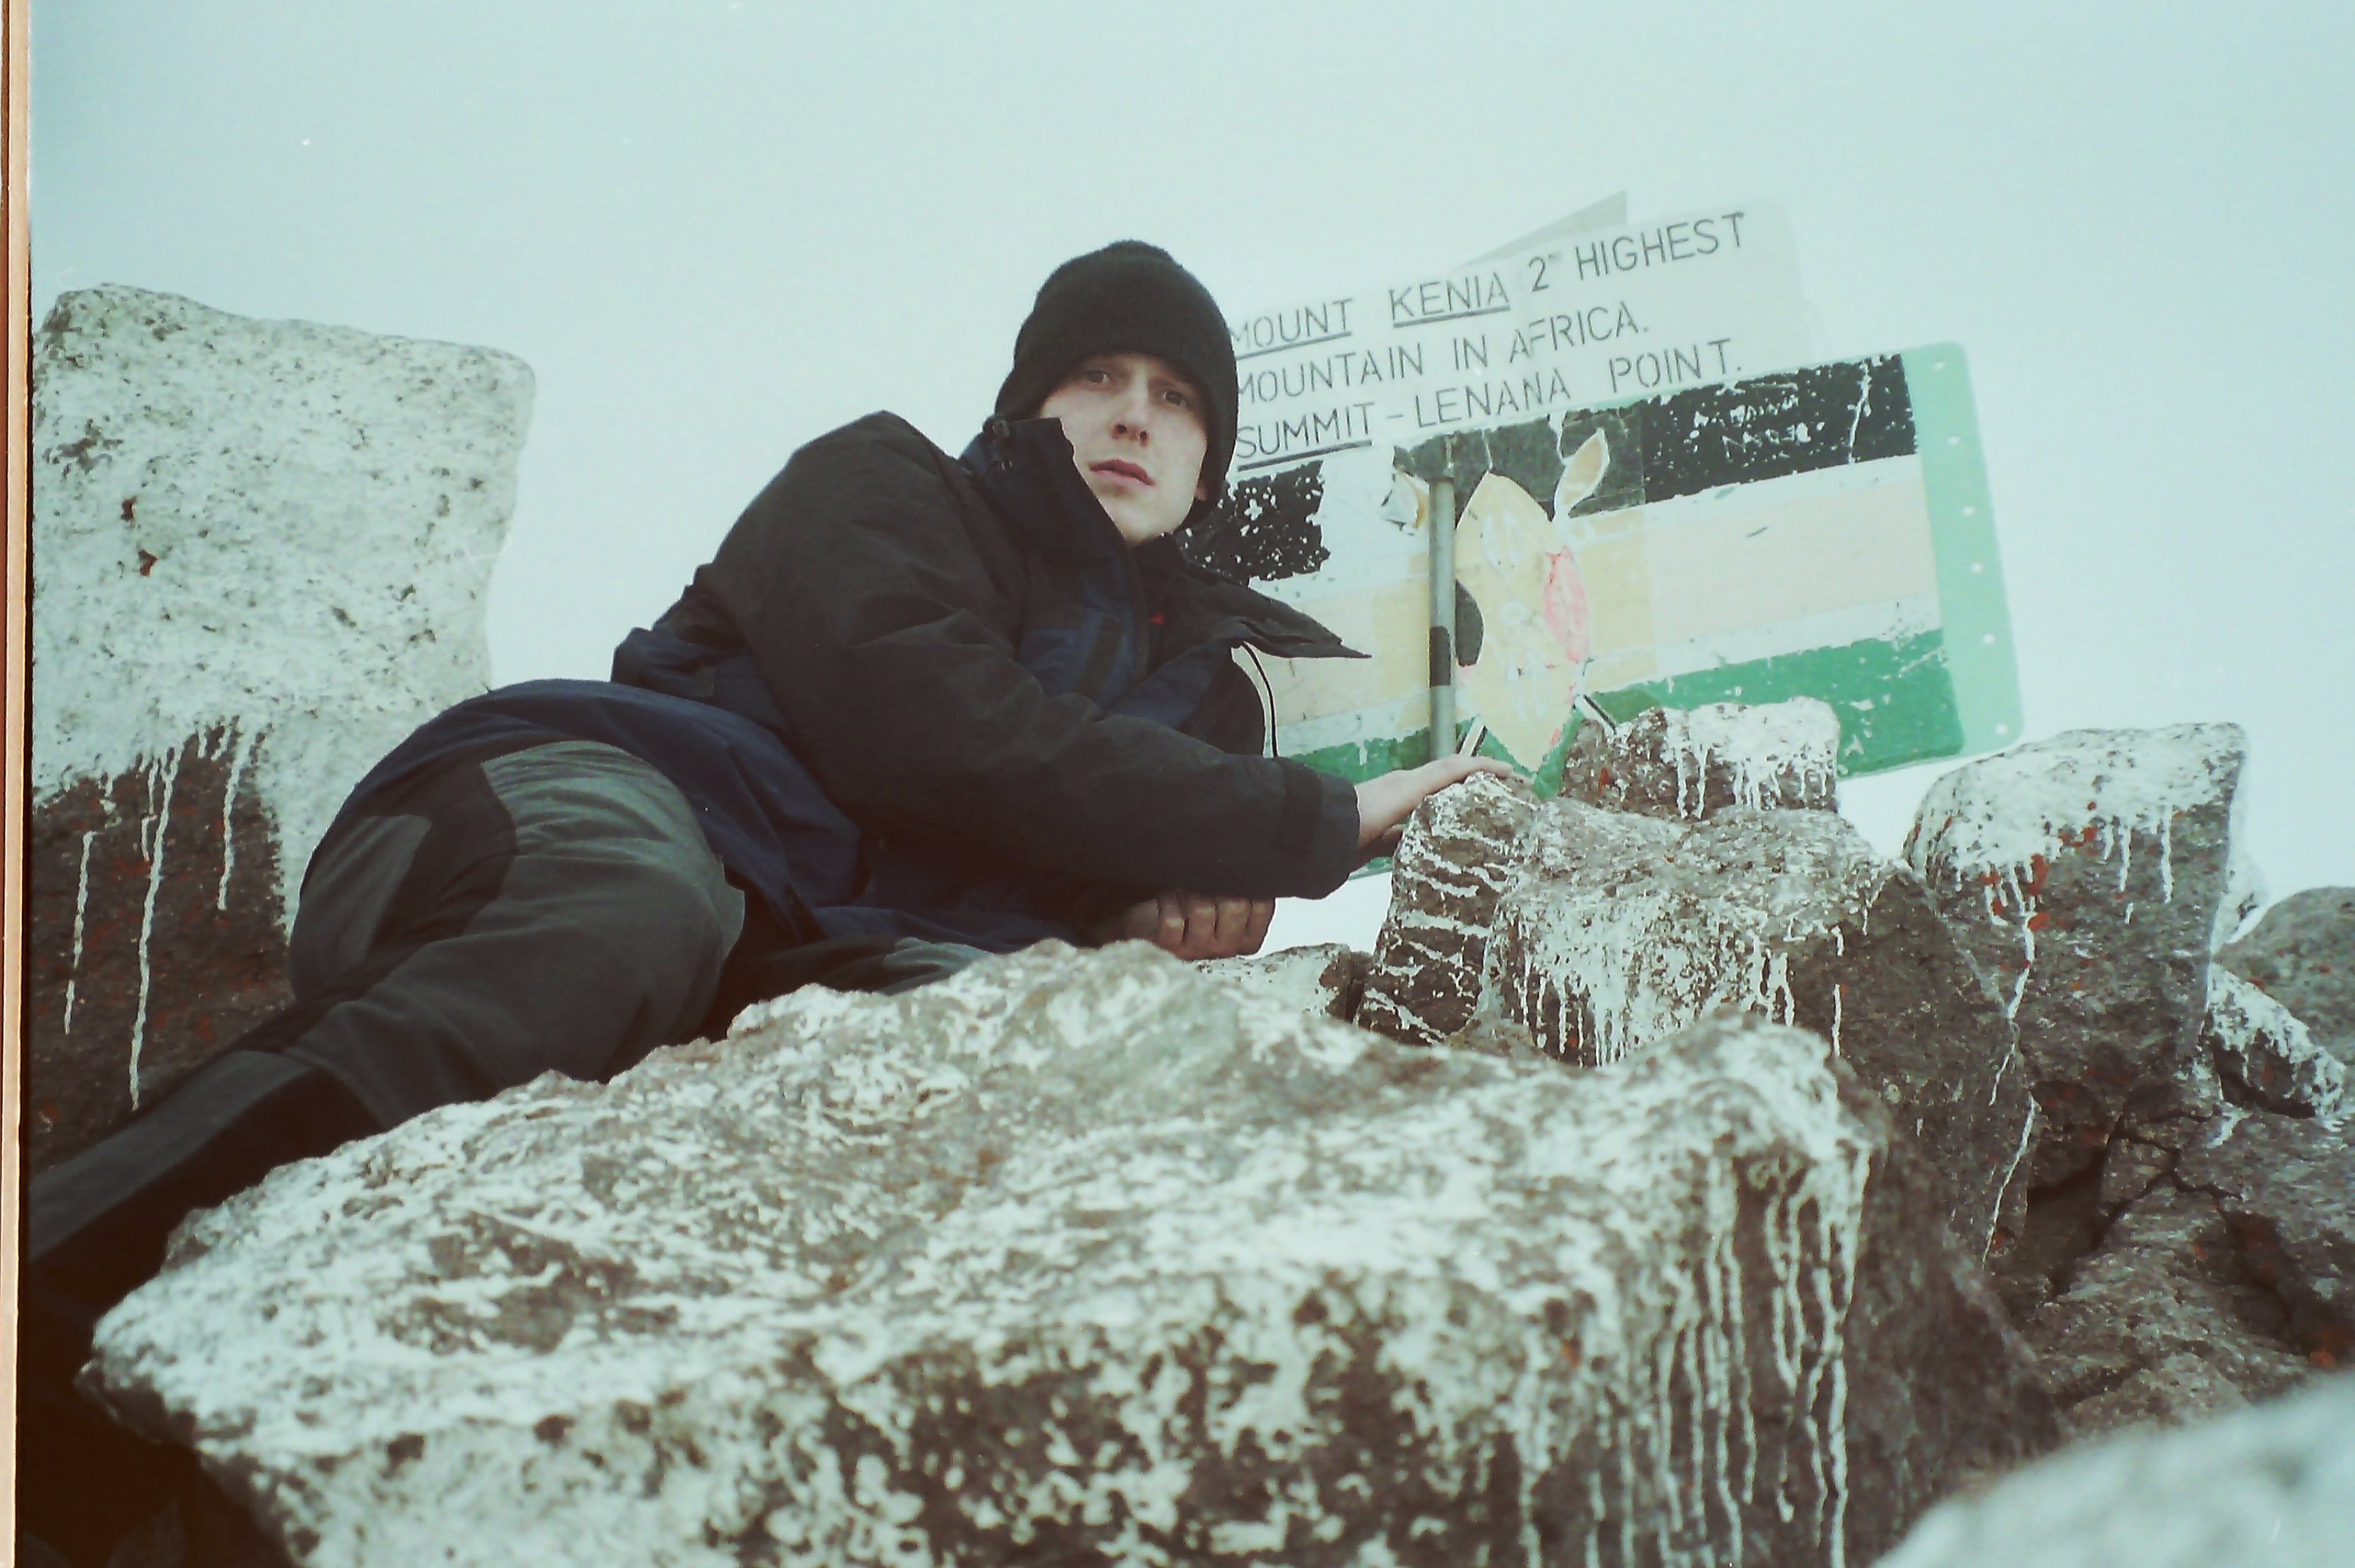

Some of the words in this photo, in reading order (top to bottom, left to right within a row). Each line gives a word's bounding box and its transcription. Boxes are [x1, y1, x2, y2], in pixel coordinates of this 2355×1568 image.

[1388, 272, 1509, 321] KENIA
[1575, 212, 1744, 281] HIGHEST
[1453, 335, 1488, 370] IN
[1509, 300, 1649, 364] AFRICA.
[1608, 338, 1741, 393] POINT.
